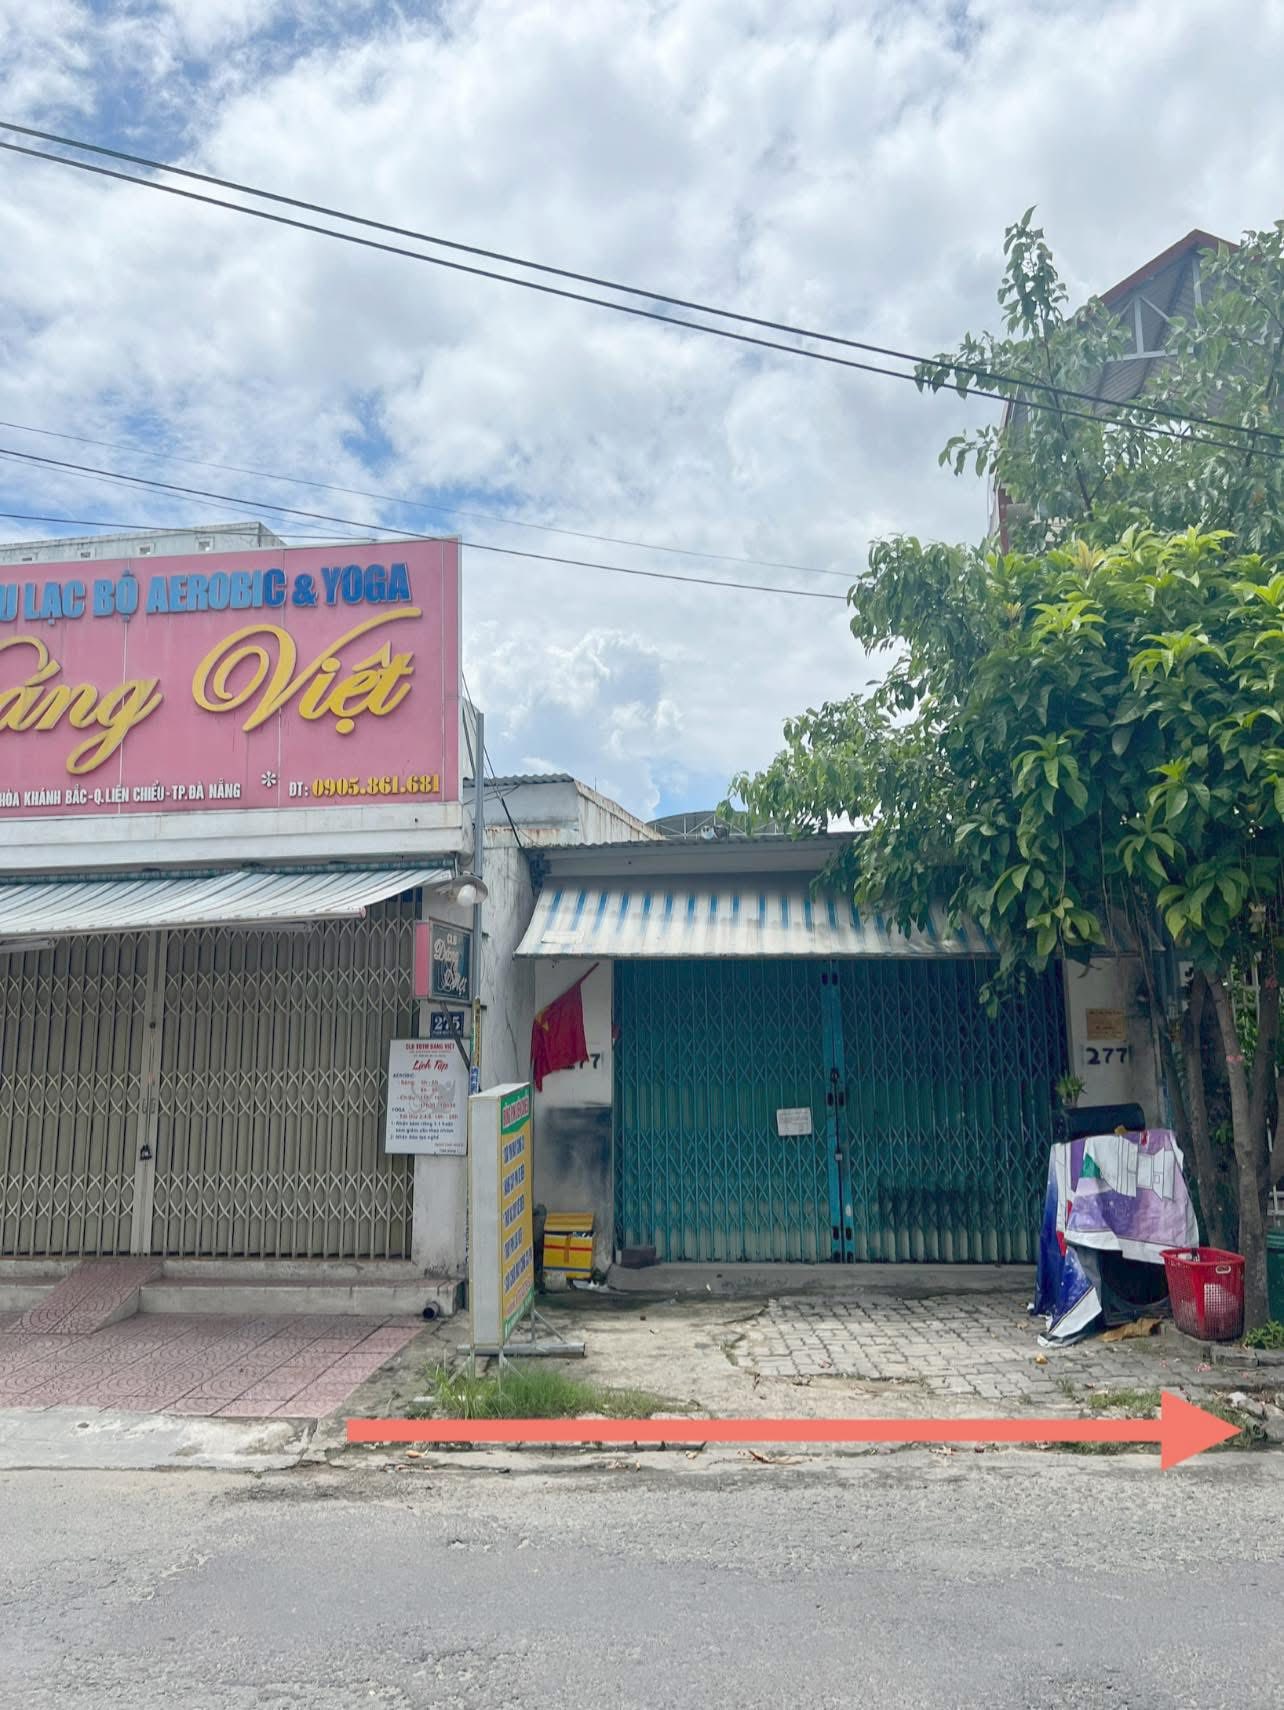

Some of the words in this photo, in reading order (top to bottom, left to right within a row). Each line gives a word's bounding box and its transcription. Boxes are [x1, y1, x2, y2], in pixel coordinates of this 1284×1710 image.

[25, 580, 85, 625] LẠC
[93, 569, 139, 622] BỘ
[146, 567, 286, 615] AEROBIC
[292, 573, 318, 607] &
[321, 561, 412, 606] YOGA
[192, 606, 424, 736] Việt
[24, 787, 61, 807] KHÁNH
[209, 777, 241, 800] NẴNG
[312, 773, 441, 798] 0905.861.681
[1086, 1046, 1127, 1064] 277
